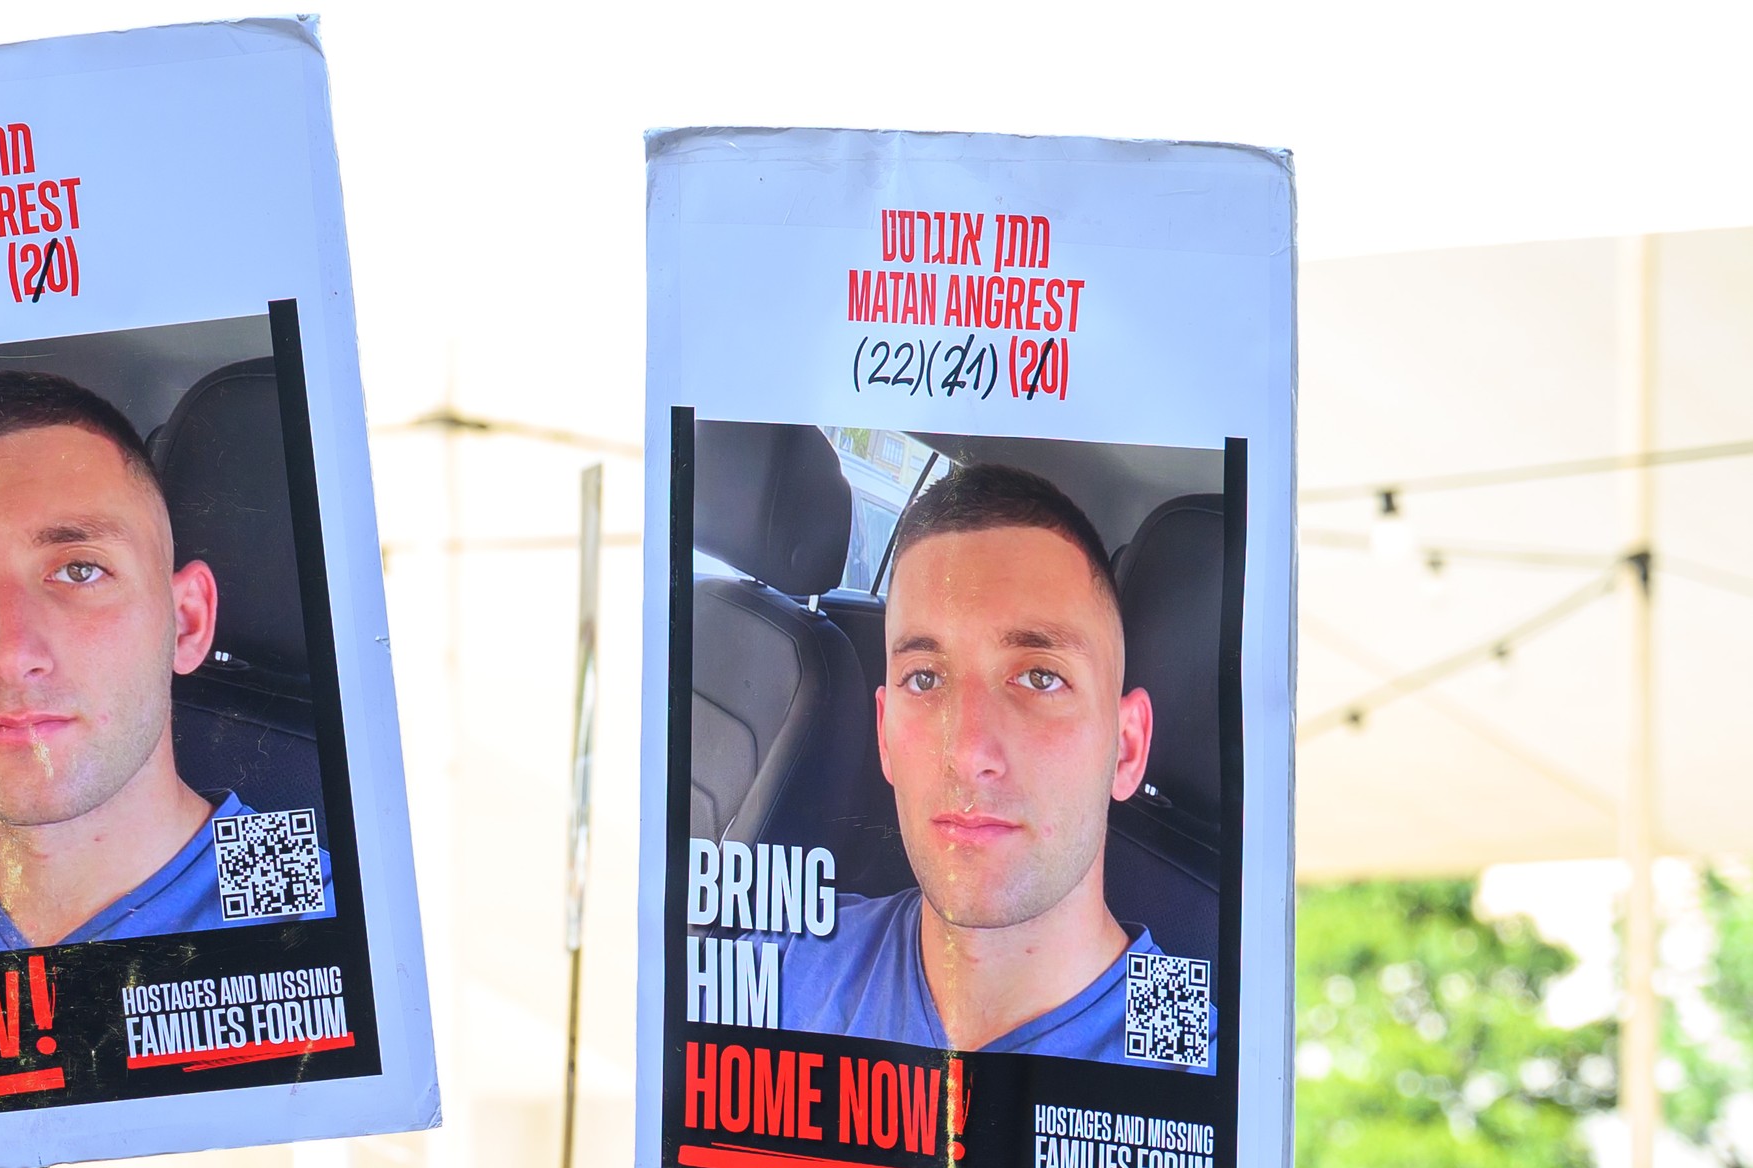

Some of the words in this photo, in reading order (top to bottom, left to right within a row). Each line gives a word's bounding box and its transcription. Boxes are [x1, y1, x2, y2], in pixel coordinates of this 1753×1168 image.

[882, 209, 984, 266] אנגרסט
[993, 214, 1050, 273] מתן
[848, 269, 937, 326] MATAN
[944, 274, 1085, 333] ANGREST
[687, 837, 836, 936] BRING
[122, 978, 217, 1017] HOSTAGES
[219, 974, 258, 1007] AND
[260, 966, 342, 1002] MISSING
[686, 936, 782, 1030] HIM
[125, 1006, 247, 1060] FAMILIES
[252, 997, 347, 1047] FORUM
[684, 1041, 825, 1141] HOME
[838, 1053, 973, 1160] NOW!
[1034, 1103, 1112, 1142] HOSTAGES
[1113, 1113, 1146, 1146] AND
[1147, 1117, 1214, 1155] MISSING
